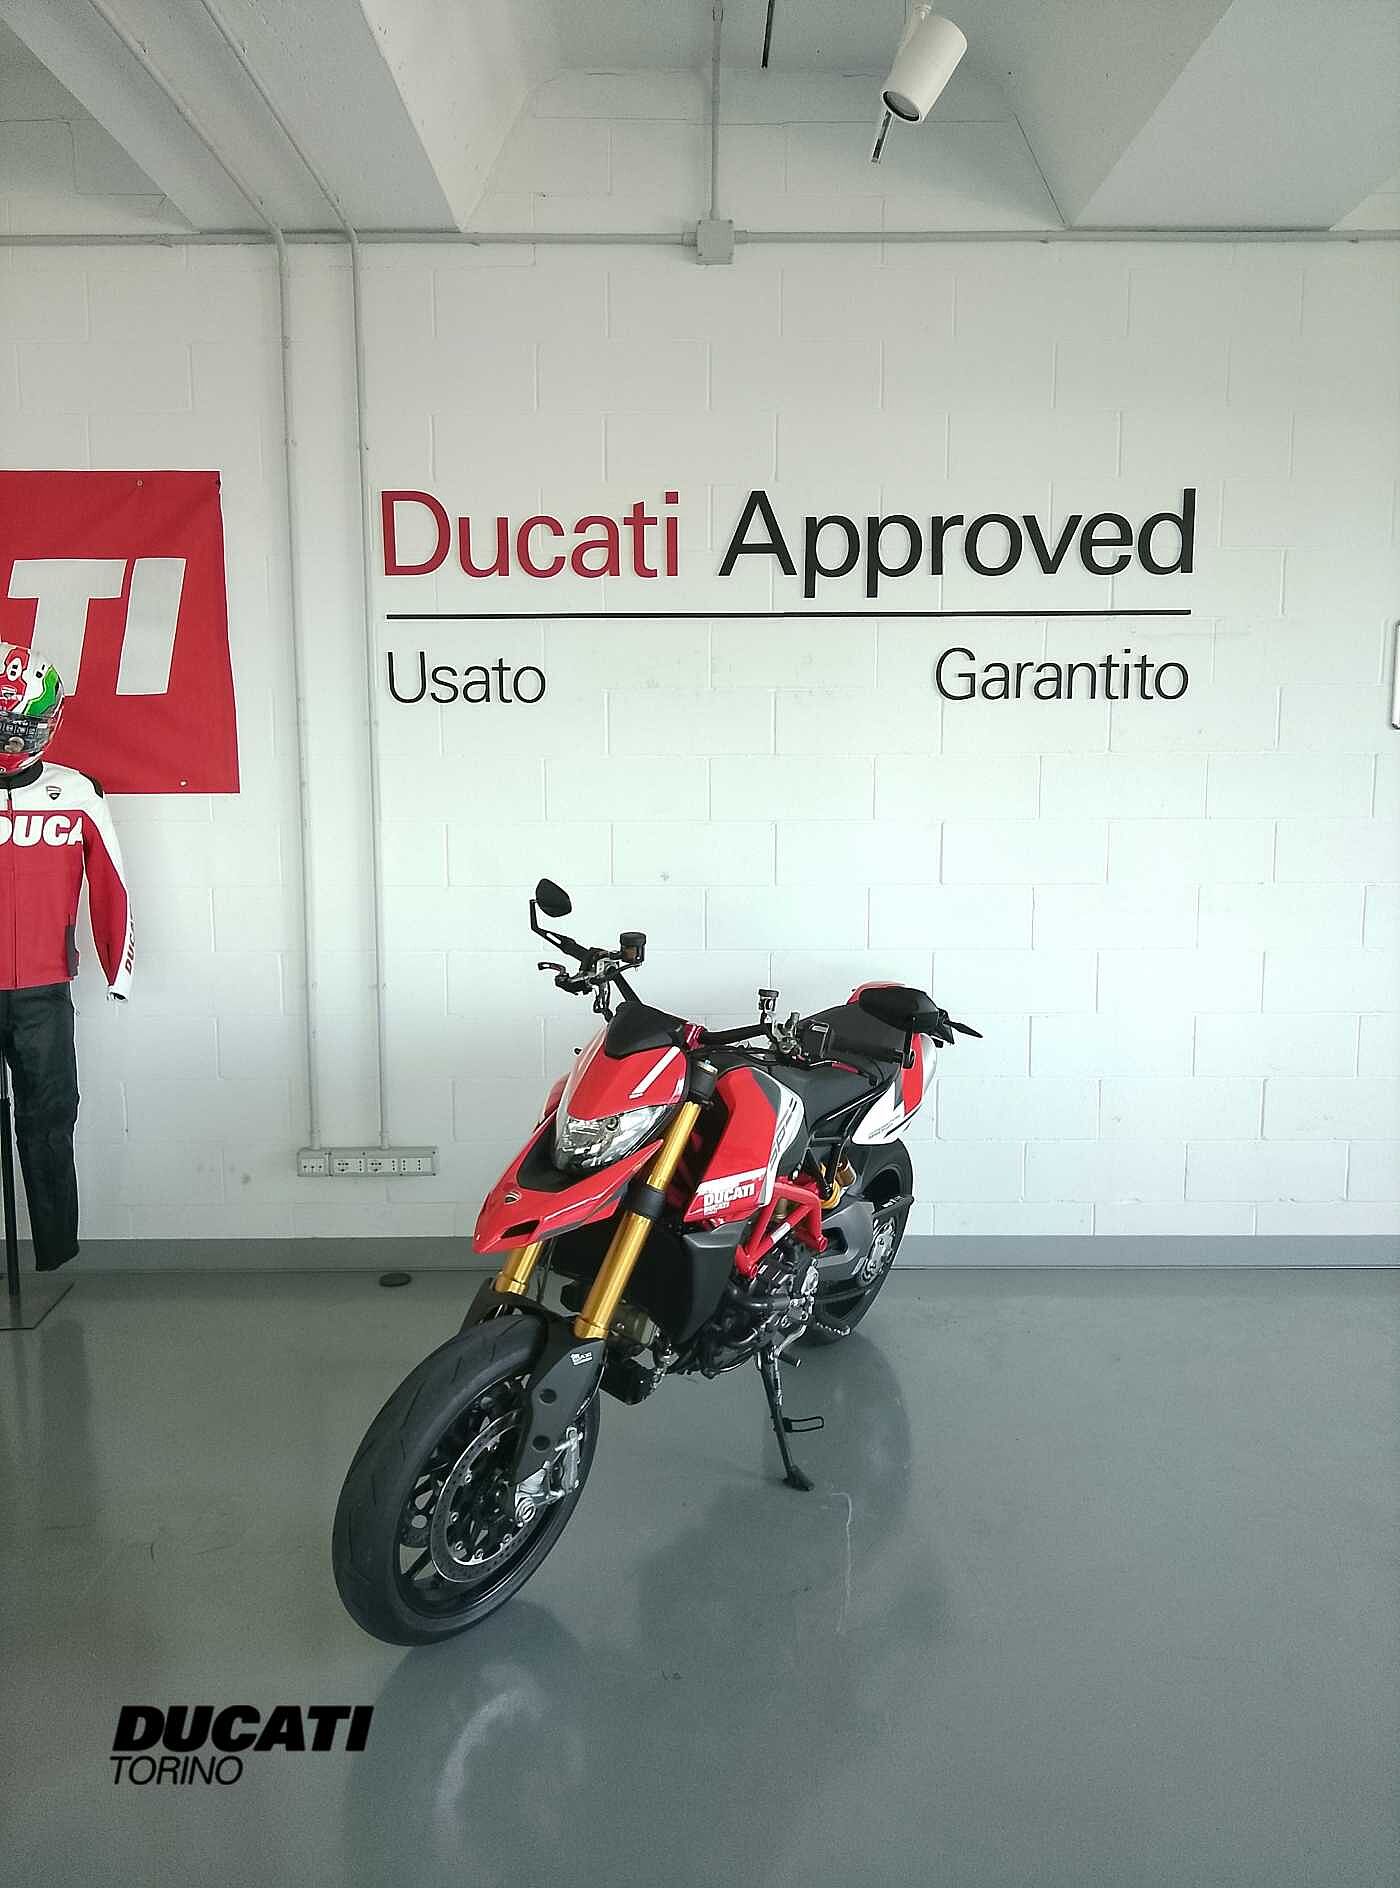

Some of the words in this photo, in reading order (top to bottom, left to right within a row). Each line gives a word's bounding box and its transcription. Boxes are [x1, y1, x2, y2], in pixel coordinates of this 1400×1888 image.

[381, 490, 679, 578] Ducati
[718, 488, 1197, 598] Approved
[387, 651, 547, 704] Usato
[936, 647, 1189, 701] Garantito
[704, 1183, 756, 1207] DUCATI
